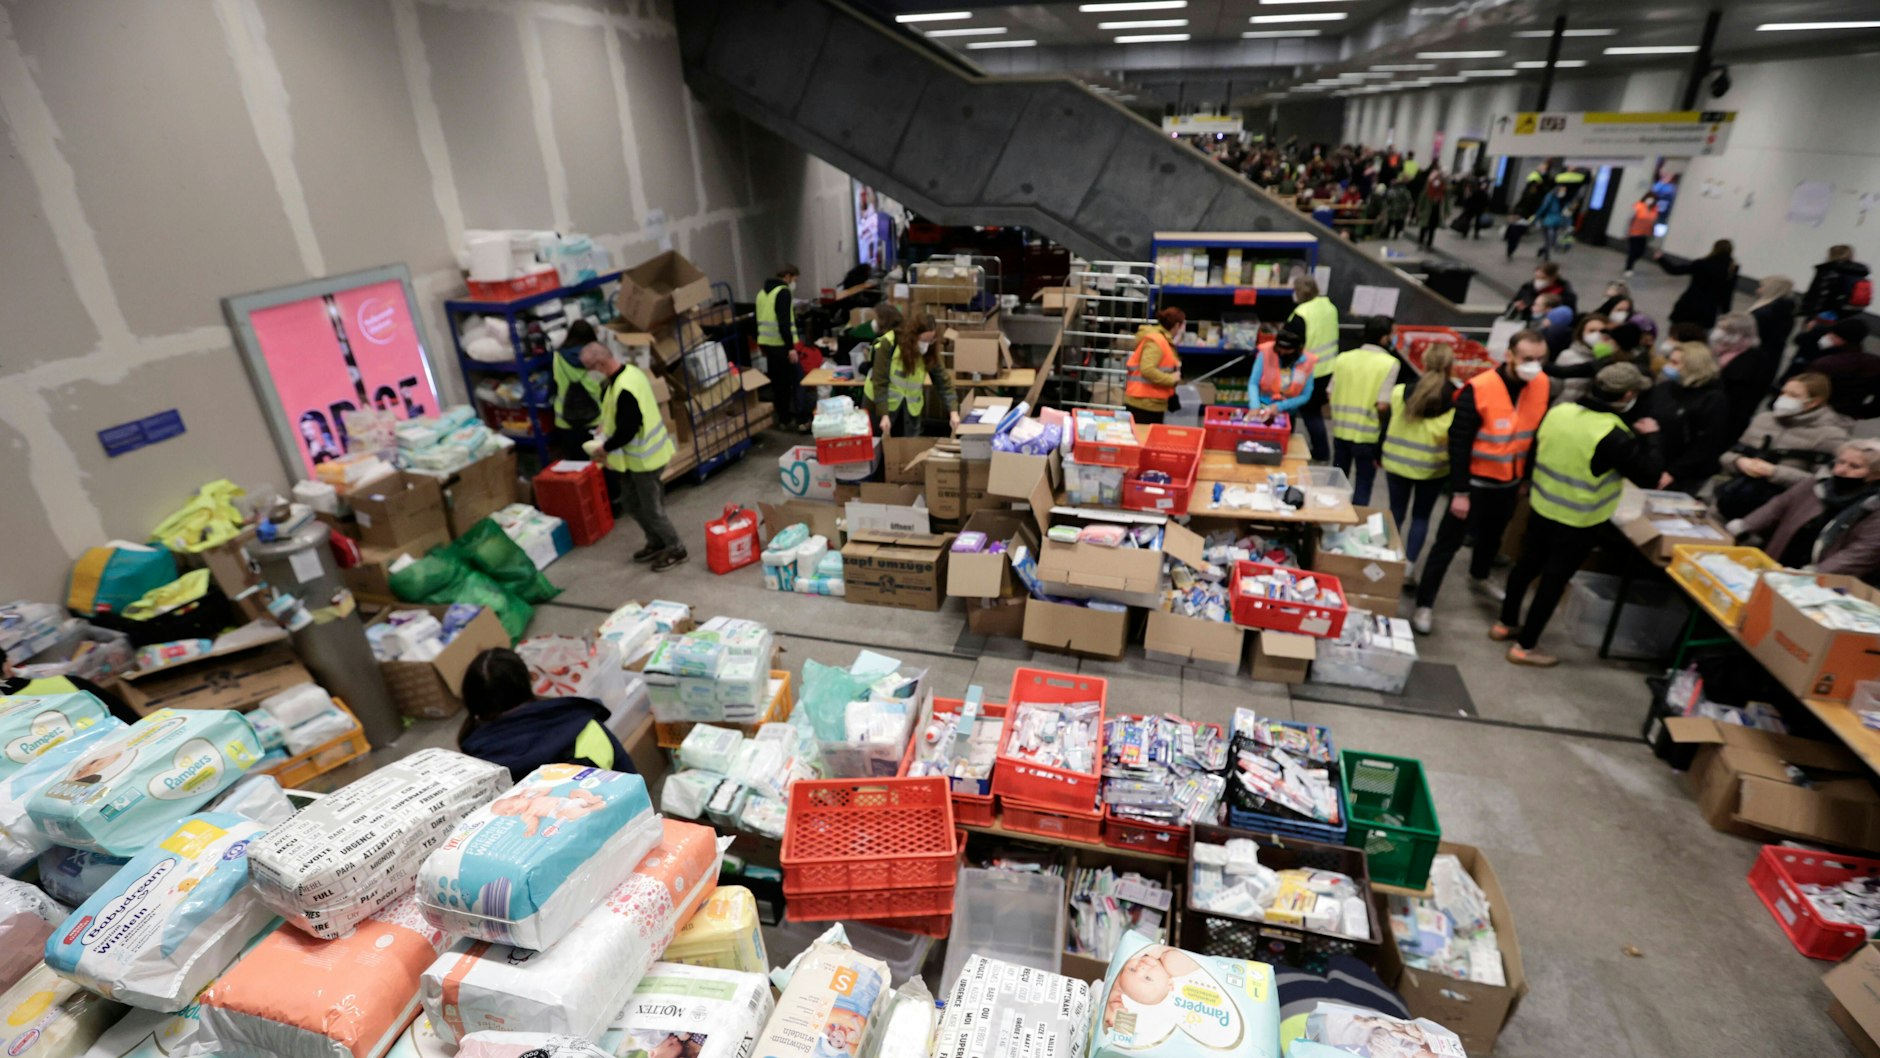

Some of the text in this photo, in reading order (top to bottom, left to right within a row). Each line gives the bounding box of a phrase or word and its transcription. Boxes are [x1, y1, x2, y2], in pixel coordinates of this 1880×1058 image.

[877, 559, 934, 574] umzüge
[165, 753, 213, 791] Pampers
[428, 800, 447, 814] TALK
[430, 815, 446, 829] DIRE
[276, 838, 299, 855] REÇU
[340, 830, 377, 856] URGENCE
[422, 836, 438, 849] YES
[466, 815, 514, 858] PREMIUM
[474, 819, 519, 859] WINDELN
[335, 860, 356, 878] PAPA
[362, 827, 404, 860] ATTENTION
[312, 889, 335, 902] FULL
[369, 848, 397, 871] MIGNON
[88, 864, 169, 940] Babydream
[360, 889, 379, 904] PLAY
[376, 887, 398, 905] DROIT
[93, 924, 122, 953] Premium
[97, 907, 148, 955] Windeln
[834, 972, 852, 993] S
[1021, 967, 1031, 983] REÇU
[953, 978, 968, 1008] URGENCE
[1062, 979, 1074, 1017] MAINTENANT
[636, 1004, 686, 1019] MOLTEX
[964, 1012, 973, 1025] MOI
[981, 1007, 990, 1019] OUI
[1174, 996, 1230, 1028] Pampers
[769, 1032, 812, 1054] Schwimm-
[783, 1026, 816, 1044] windeln
